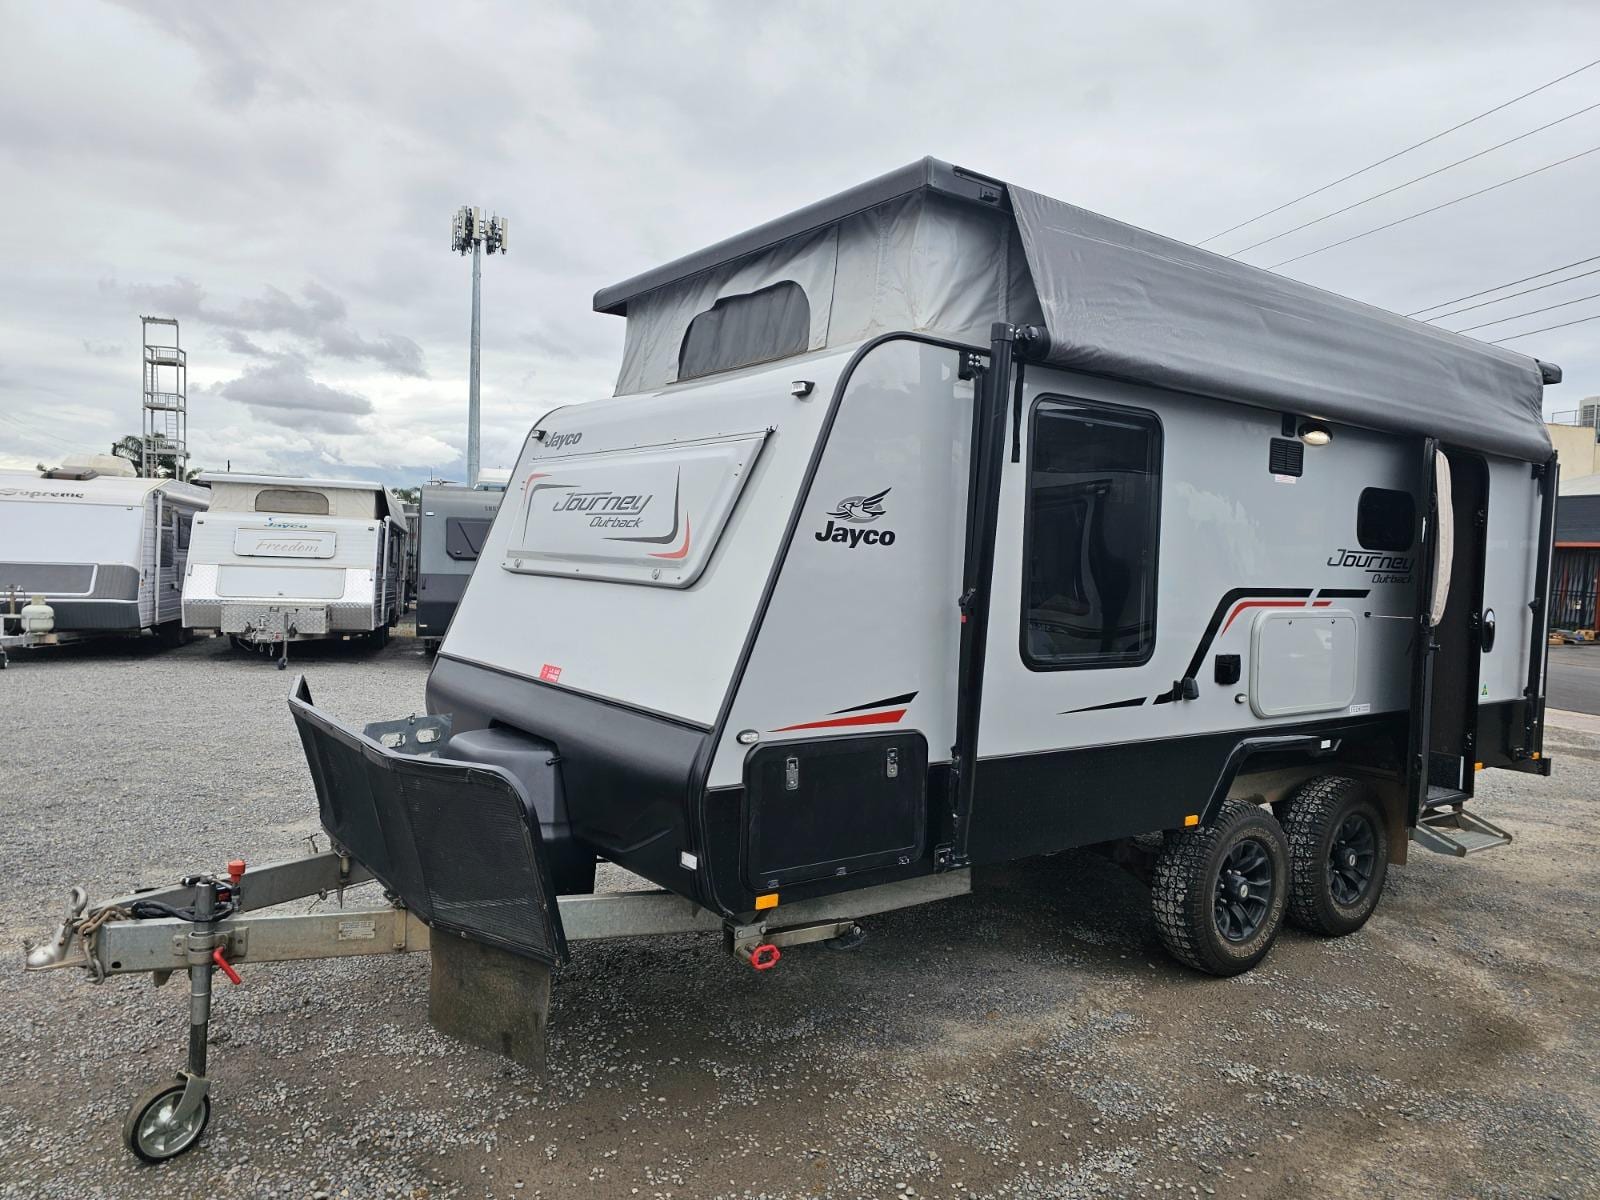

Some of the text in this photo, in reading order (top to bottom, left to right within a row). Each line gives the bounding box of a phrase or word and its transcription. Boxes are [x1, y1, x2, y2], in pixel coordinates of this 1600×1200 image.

[545, 431, 582, 450] Jayco
[552, 491, 653, 515] Journey
[589, 516, 643, 528] Outback
[814, 520, 896, 549] Jayco
[255, 539, 320, 553] Freedom
[1327, 548, 1416, 573] Journey
[1372, 573, 1415, 584] Outback
